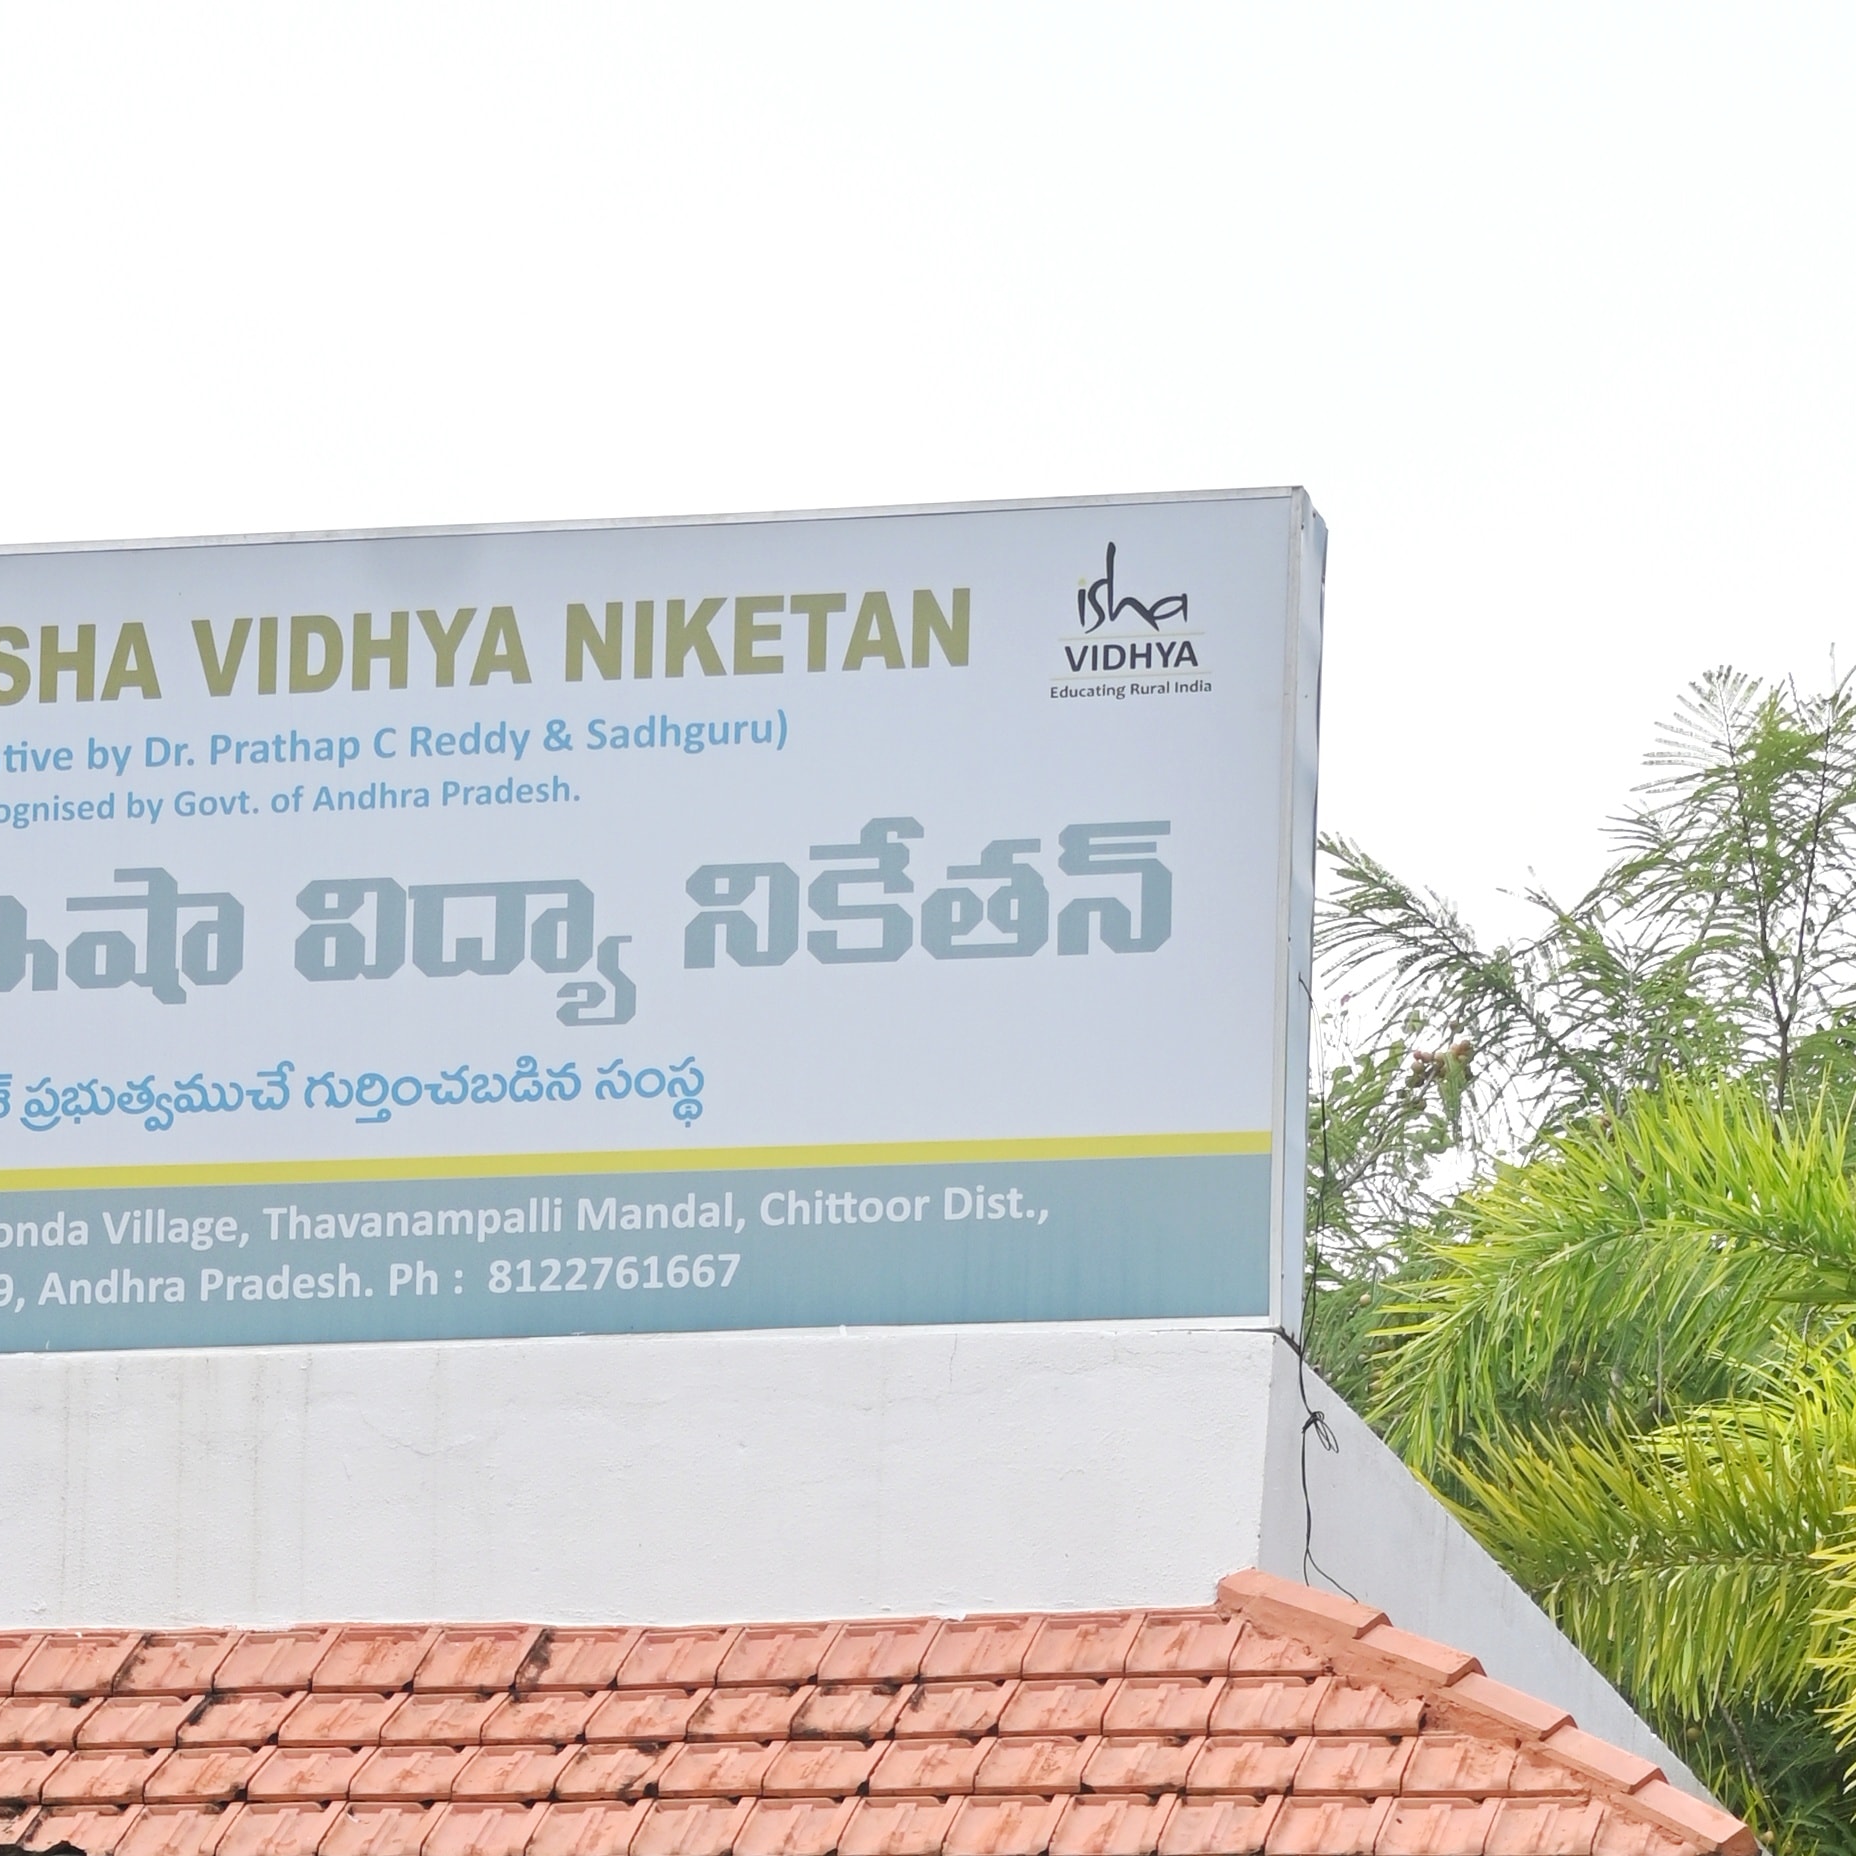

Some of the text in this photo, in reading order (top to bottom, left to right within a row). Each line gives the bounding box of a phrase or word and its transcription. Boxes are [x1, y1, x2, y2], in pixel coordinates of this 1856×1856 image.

[1078, 542, 1187, 633] isha
[191, 606, 532, 696] VIDHYA
[565, 588, 970, 682] NIKETAN
[1065, 641, 1198, 672] VIDHYA
[1051, 680, 1211, 700] Educating Rural India
[88, 737, 132, 776] by
[146, 737, 194, 767] Dr.
[211, 730, 360, 768] Prathap
[374, 728, 396, 758] C
[411, 721, 530, 761] Reddy
[543, 719, 573, 751] &
[587, 709, 787, 754] Sadhguru)
[127, 792, 163, 824] by
[174, 791, 258, 816] Govt.
[271, 785, 304, 813] of
[313, 782, 429, 811] Andhra
[443, 775, 580, 806] Pradesh.
[294, 877, 636, 1026] విద్యా
[684, 817, 1172, 969] నికేతన్
[20, 1060, 295, 1131] ప్రభుత్వముచే
[304, 1055, 581, 1123] గుర్తించబడిన
[595, 1056, 704, 1128] సంస్థ
[103, 1209, 249, 1250] Village,
[263, 1197, 562, 1242] Thavanampalli
[578, 1192, 745, 1233] Mandal,
[760, 1190, 930, 1225] Chittoor
[944, 1185, 1048, 1224] Dist.,
[38, 1269, 184, 1305] Andhra
[201, 1263, 373, 1301] Pradesh.
[390, 1261, 438, 1296] Ph
[489, 1254, 740, 1293] 8122761667
